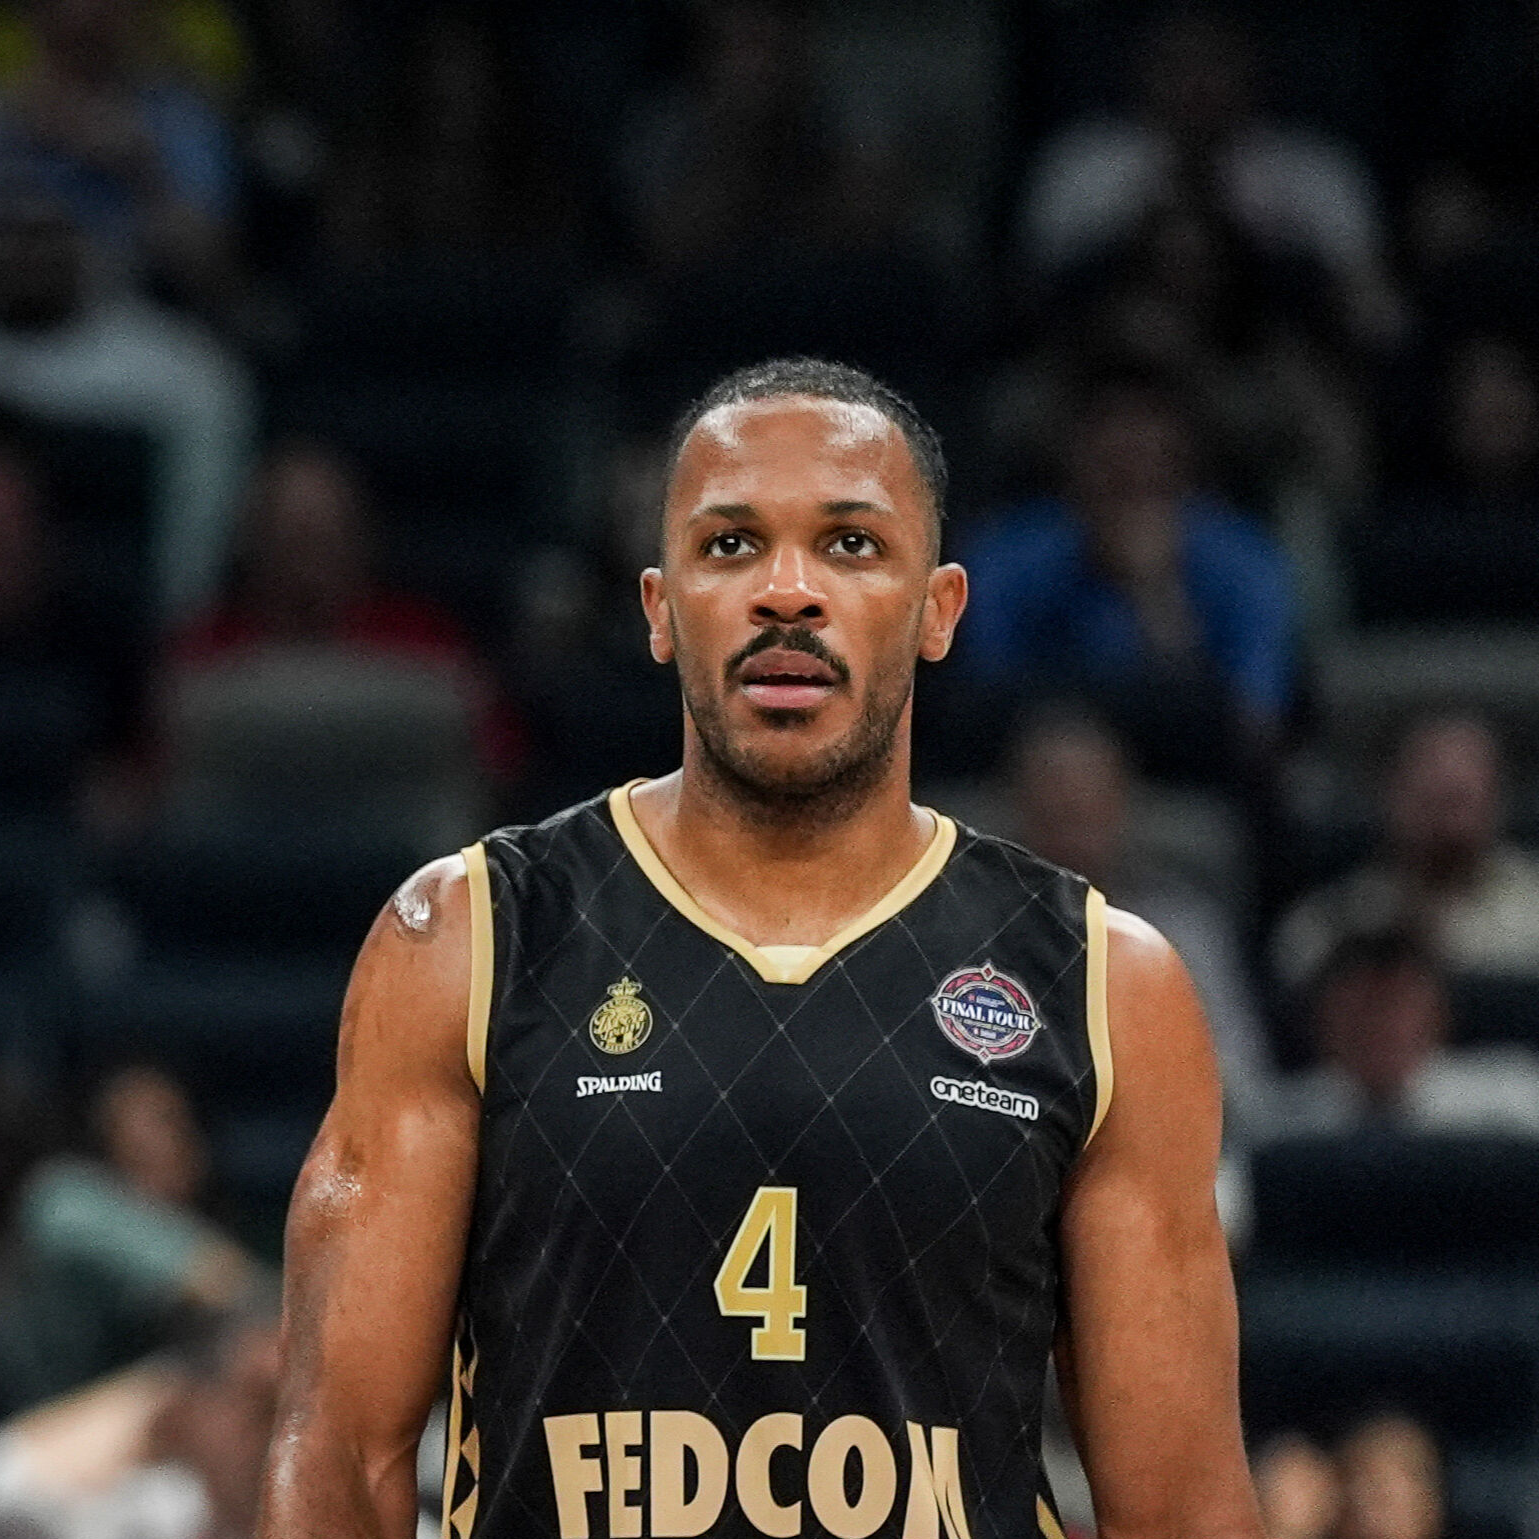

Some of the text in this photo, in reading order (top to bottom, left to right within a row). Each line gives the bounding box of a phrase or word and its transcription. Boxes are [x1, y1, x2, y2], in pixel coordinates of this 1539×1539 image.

[942, 998, 986, 1023] FINAL
[988, 1009, 1030, 1031] FOUR
[576, 1070, 663, 1098] SPALDING
[933, 1080, 1037, 1118] oneteam
[713, 1186, 808, 1362] 4
